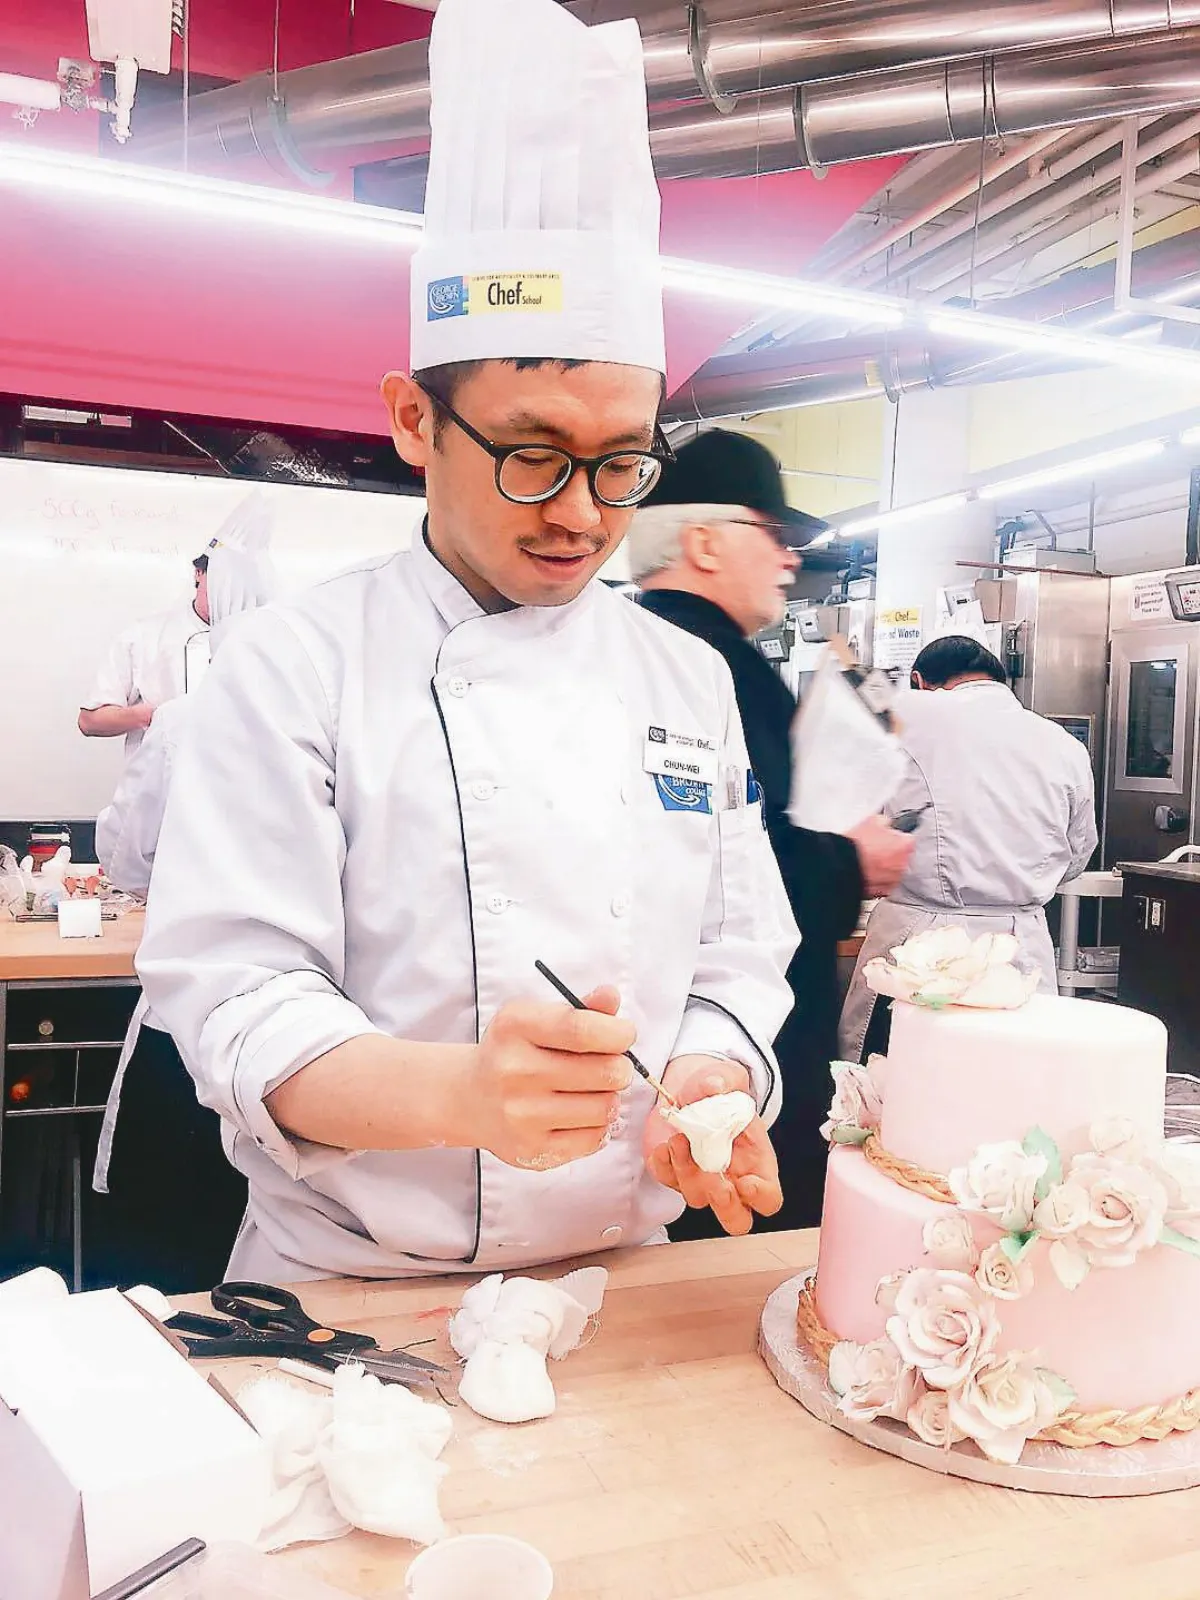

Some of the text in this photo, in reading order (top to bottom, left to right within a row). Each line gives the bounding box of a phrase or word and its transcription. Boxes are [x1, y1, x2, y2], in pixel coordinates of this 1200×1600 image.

[488, 281, 542, 305] Chef School
[898, 628, 920, 639] Waste
[663, 759, 700, 774] CHUN-WEI
